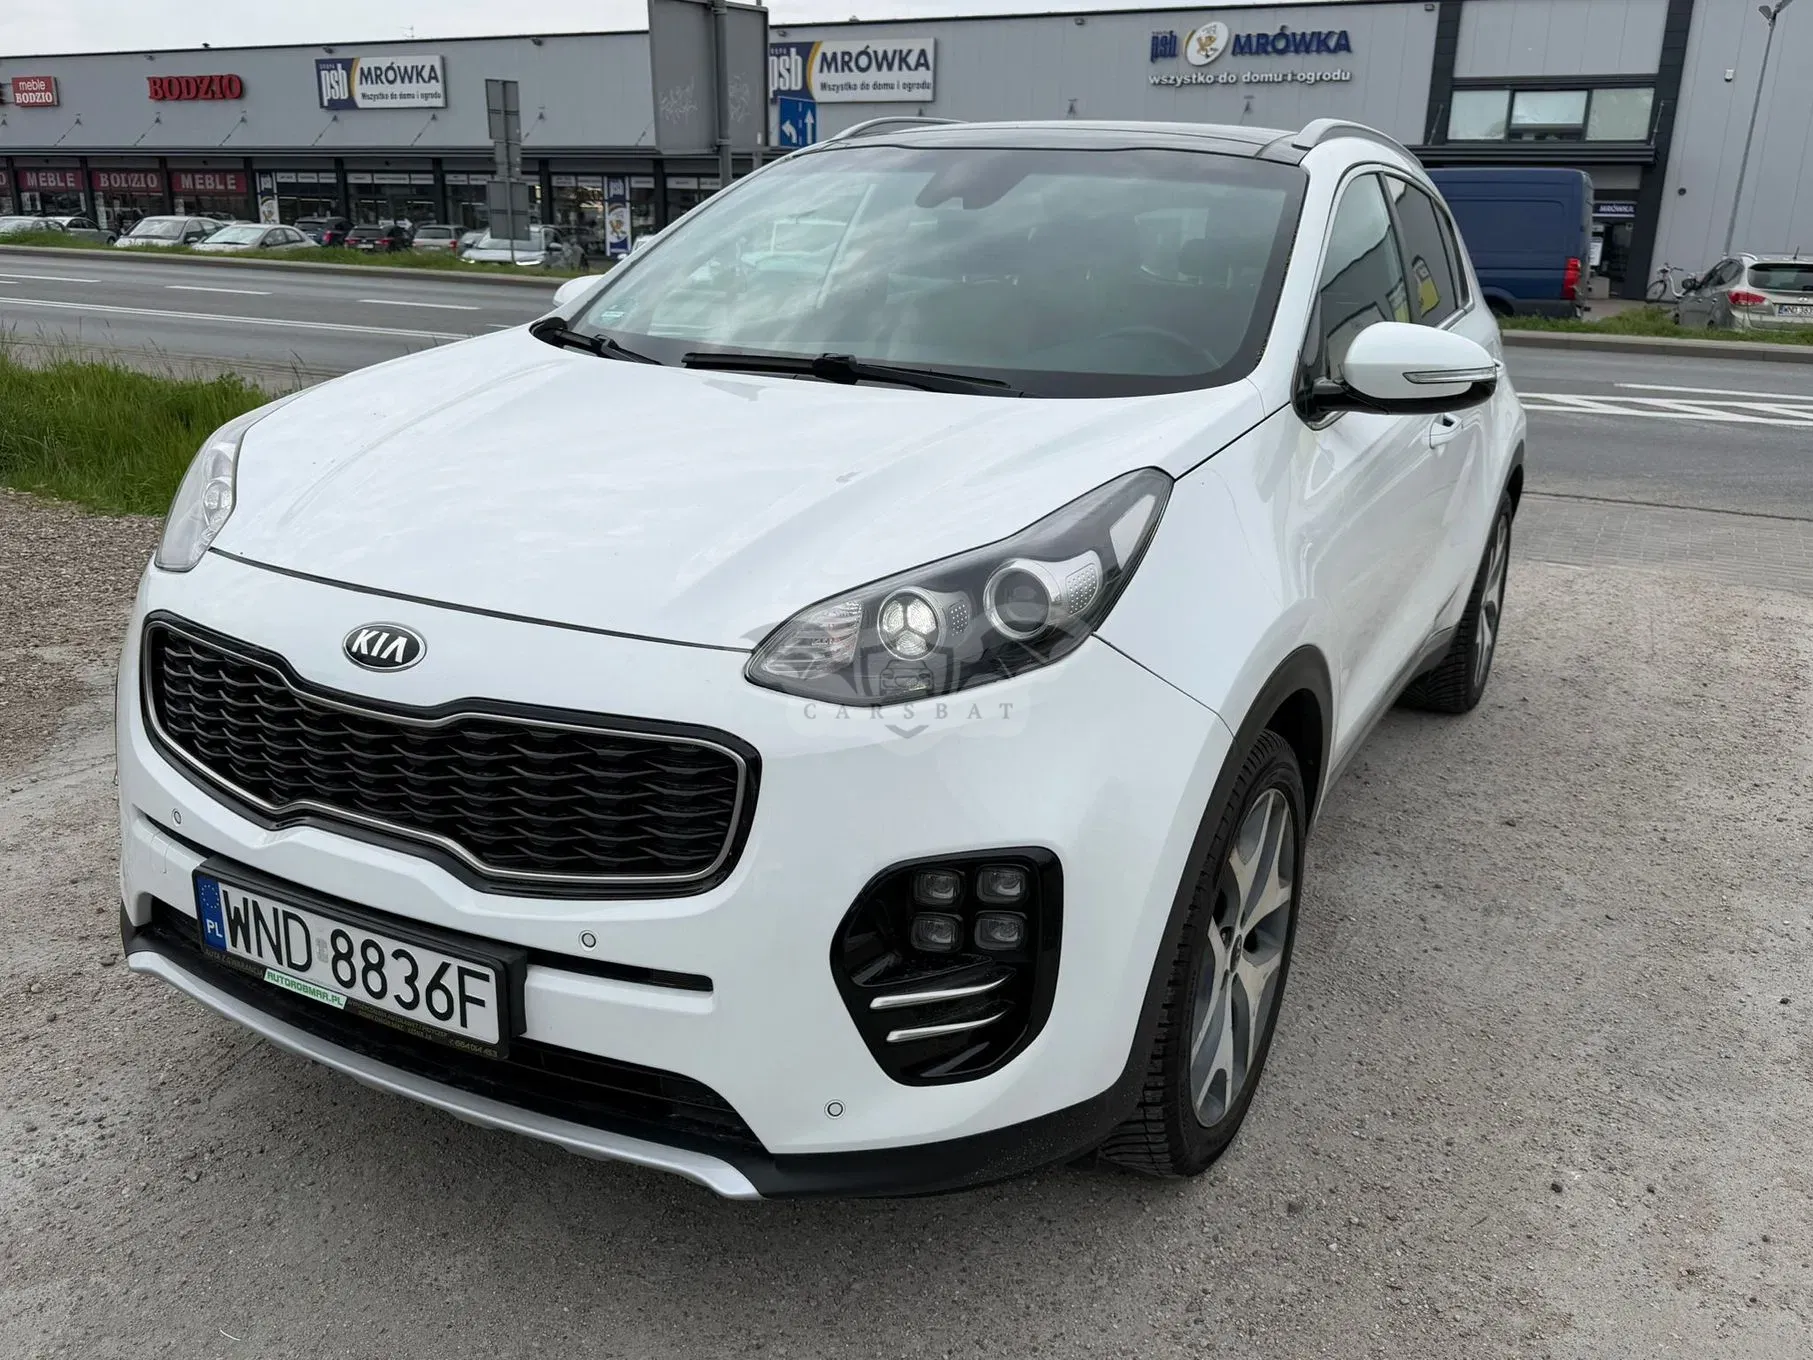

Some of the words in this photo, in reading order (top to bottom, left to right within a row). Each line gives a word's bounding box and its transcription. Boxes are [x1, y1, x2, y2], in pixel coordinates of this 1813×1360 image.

[1231, 25, 1352, 56] MRÓWKA
[819, 45, 930, 73] MRÓWKA
[320, 63, 349, 106] psb
[359, 62, 440, 86] MRÓWKA
[769, 47, 803, 98] psb
[1149, 71, 1214, 87] wszystko
[1218, 72, 1237, 84] do
[1242, 70, 1282, 83] domu
[1297, 69, 1351, 84] ogrodu
[19, 79, 45, 91] meble
[147, 74, 243, 100] BODZIO
[820, 81, 858, 94] Wszystko
[860, 81, 870, 90] do
[872, 80, 895, 90] domu
[902, 79, 932, 92] ogrodu
[15, 92, 53, 104] BODZIO
[27, 172, 75, 188] MEBLE
[100, 173, 157, 188] BODZIO
[181, 173, 236, 190] MEBLE
[351, 629, 408, 663] KIA
[206, 919, 223, 938] PL
[222, 889, 313, 973] WND
[330, 927, 491, 1030] 8836F
[266, 970, 344, 1007] AUTOROBMAR.PL
